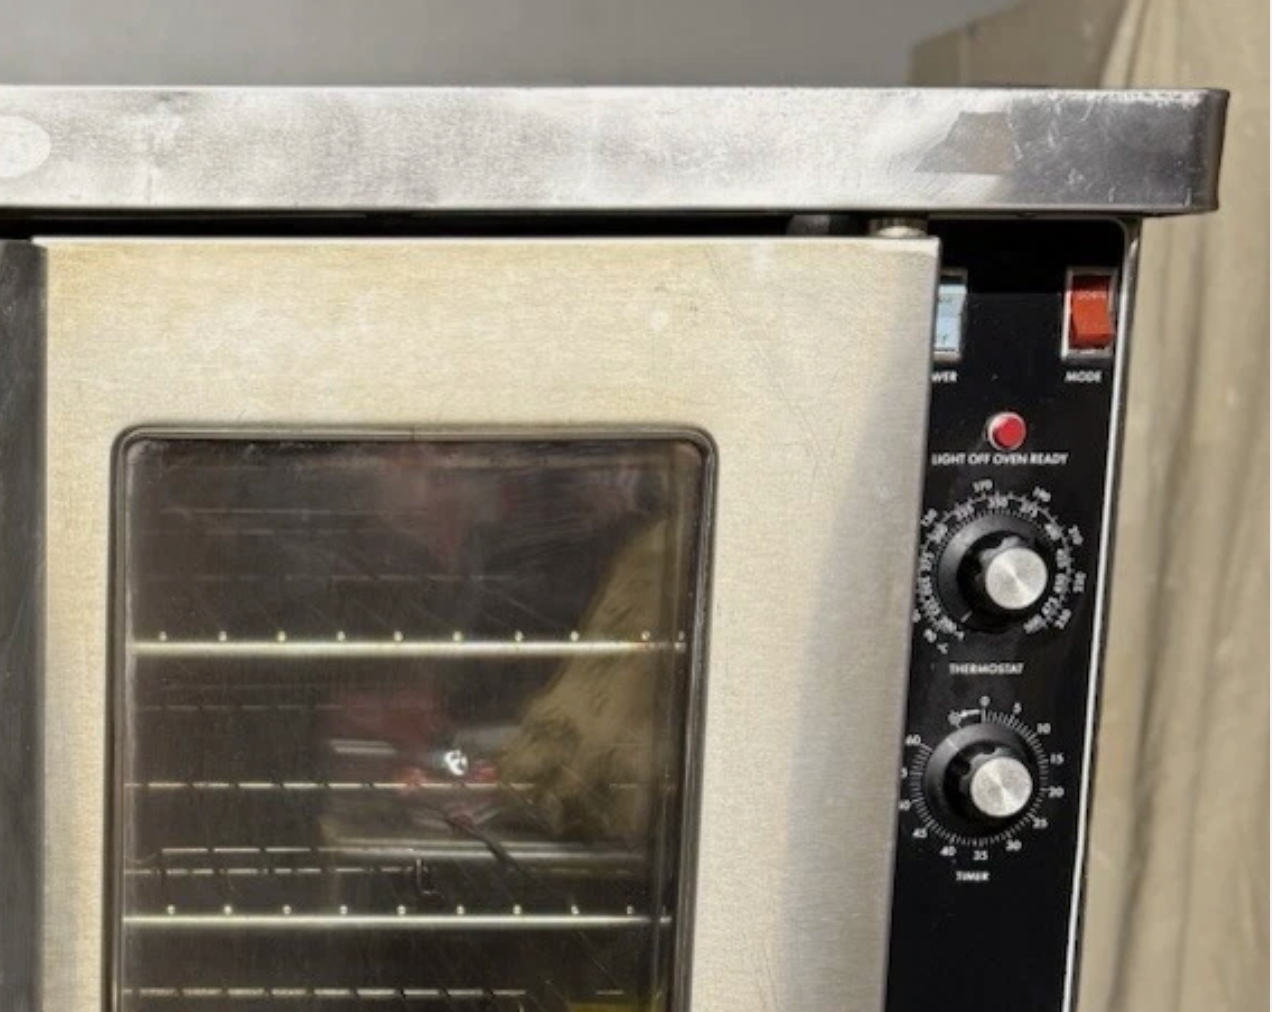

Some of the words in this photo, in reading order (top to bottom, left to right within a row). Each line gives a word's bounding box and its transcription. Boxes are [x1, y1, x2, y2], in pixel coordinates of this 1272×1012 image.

[1064, 371, 1102, 382] MODE
[931, 453, 966, 465] LIGHT
[968, 453, 990, 465] OFF
[992, 453, 1028, 465] OVEN
[1030, 453, 1069, 465] READY
[949, 663, 1024, 674] THERMOSTAT
[1013, 702, 1022, 714] 5
[1037, 723, 1051, 734] 10
[906, 733, 921, 746] 60
[1050, 753, 1065, 765] 15
[1049, 786, 1064, 798] 20
[1032, 818, 1048, 829] 25
[912, 827, 927, 839] 45
[1006, 839, 1022, 851] 30
[940, 846, 957, 857] 40
[973, 850, 988, 861] 35
[956, 870, 990, 882] TIMER
